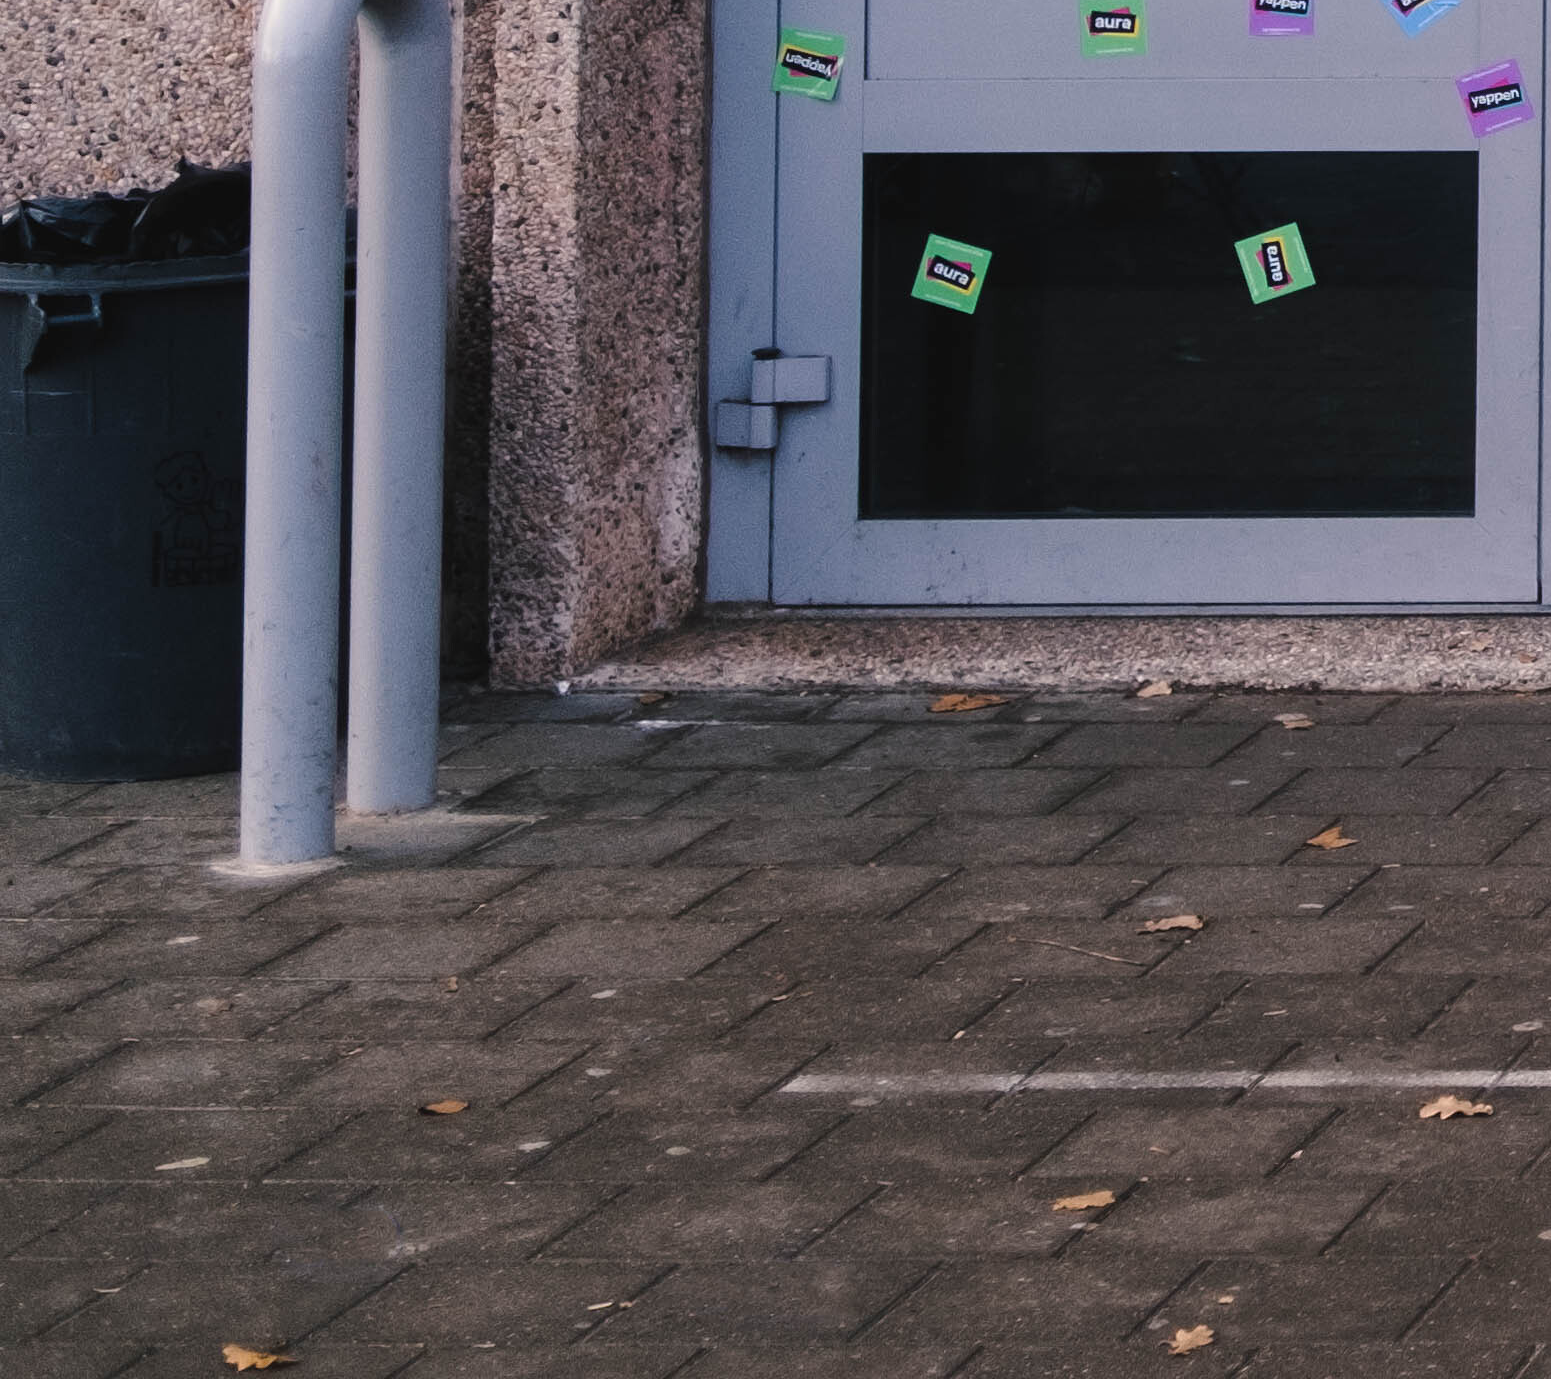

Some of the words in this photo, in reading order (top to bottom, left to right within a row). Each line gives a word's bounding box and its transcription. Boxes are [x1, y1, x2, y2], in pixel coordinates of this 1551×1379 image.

[1095, 17, 1132, 30] aura
[785, 53, 832, 77] yappen
[1471, 89, 1520, 108] yappen
[934, 263, 969, 285] aura
[1267, 245, 1283, 281] aura
